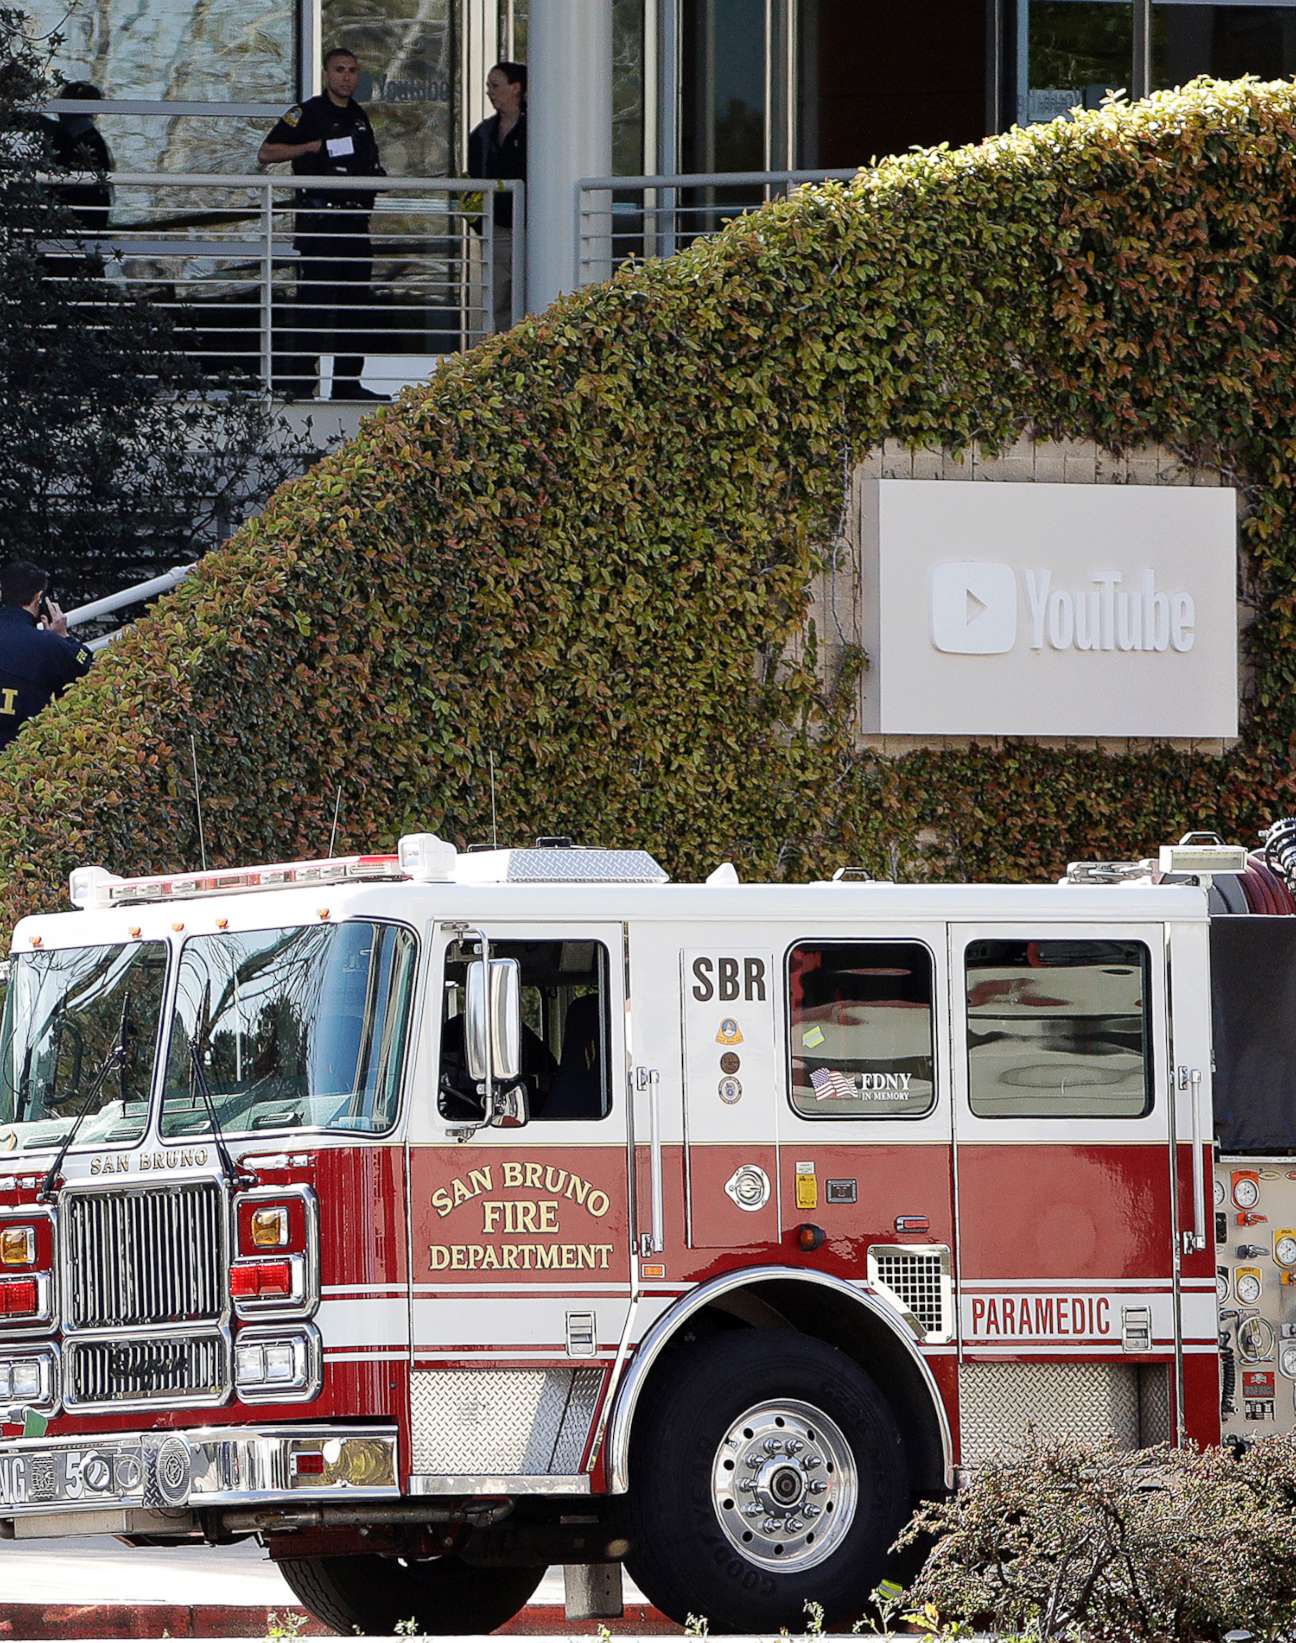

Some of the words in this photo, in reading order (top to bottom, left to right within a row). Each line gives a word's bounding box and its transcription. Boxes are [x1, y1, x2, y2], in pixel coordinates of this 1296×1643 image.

[1025, 568, 1195, 653] YouTube
[692, 956, 767, 1002] SBR
[861, 1072, 913, 1091] FDNY
[862, 1091, 872, 1101] IN
[876, 1091, 910, 1101] MEMORY
[90, 1154, 130, 1176] SAN
[139, 1147, 209, 1171] BRUNO
[431, 1165, 494, 1218] SAN
[501, 1161, 611, 1218] BRUNO
[481, 1200, 561, 1234] FIRE
[428, 1244, 615, 1271] DEPARTMENT
[971, 1297, 1110, 1335] PARAMEDIC
